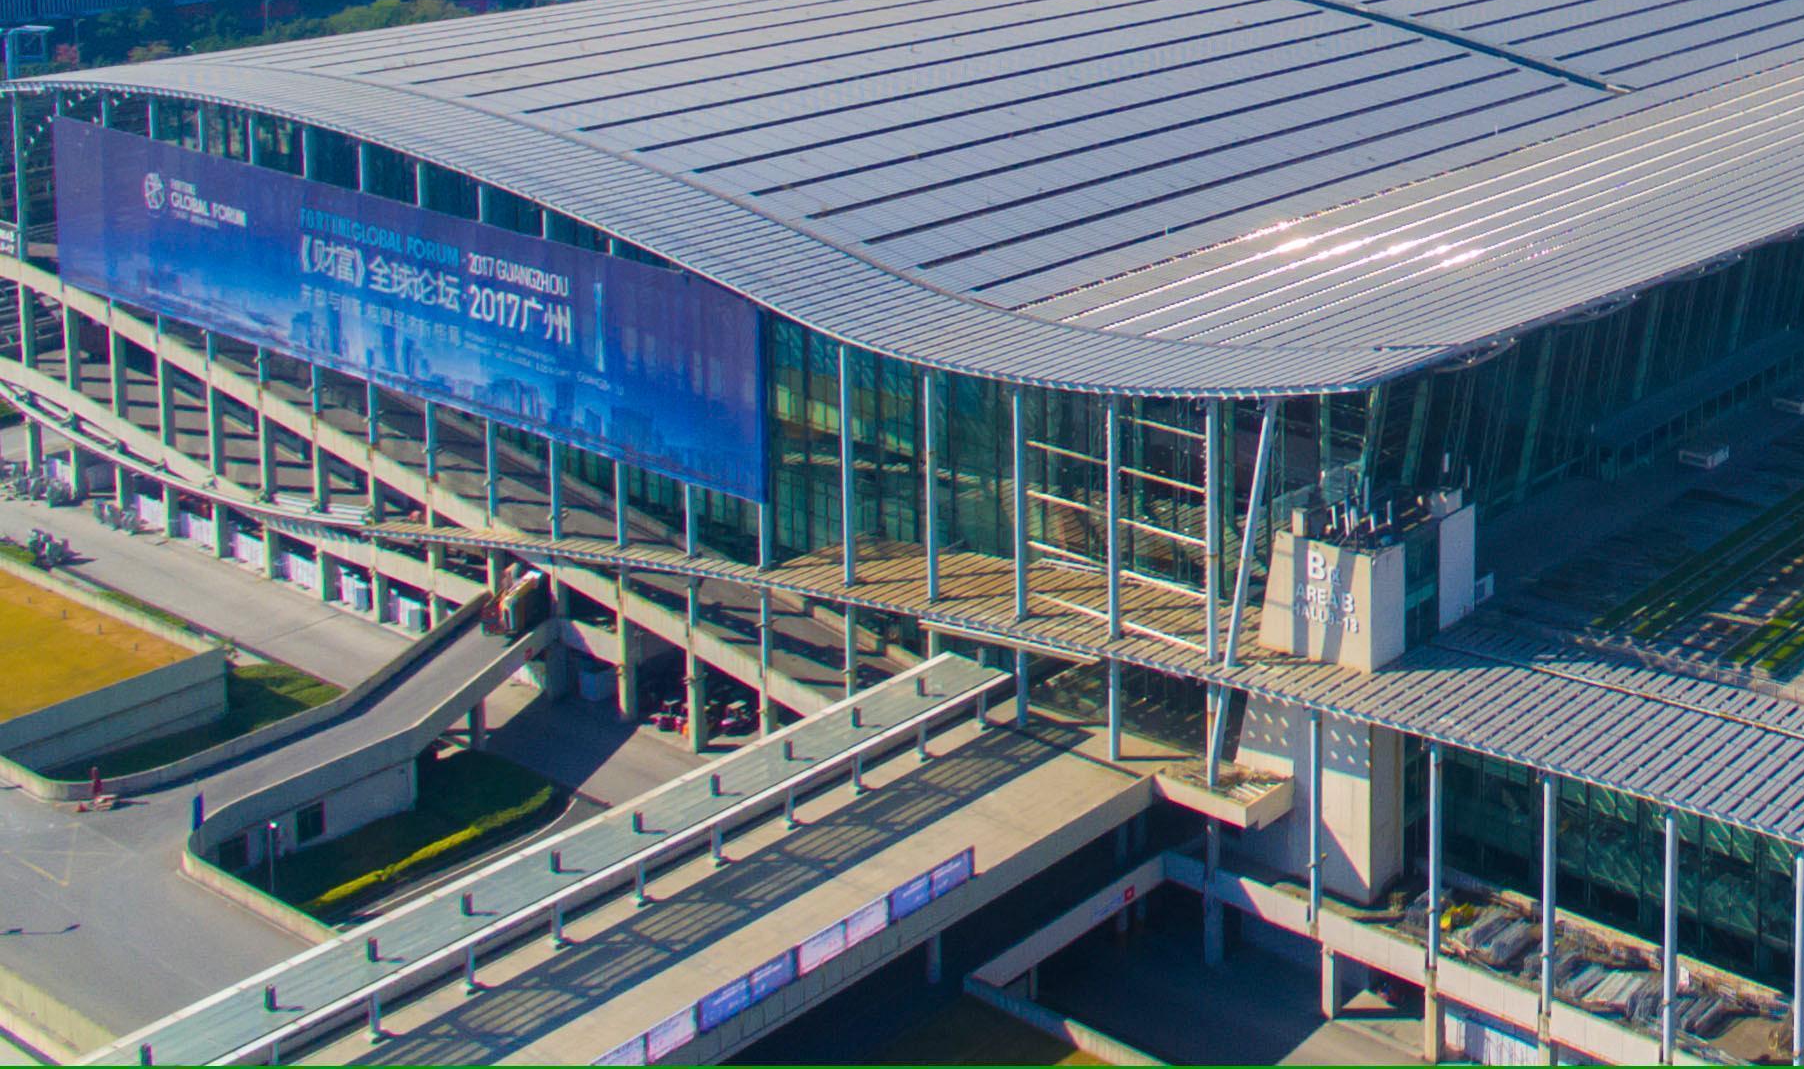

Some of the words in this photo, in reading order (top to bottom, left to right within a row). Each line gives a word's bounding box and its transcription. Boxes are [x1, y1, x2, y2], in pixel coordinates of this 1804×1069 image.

[352, 221, 403, 252] GLOBAL
[406, 235, 460, 267] FORUM
[467, 252, 494, 277] 2017
[495, 259, 569, 297] GUANGZHOU
[1296, 583, 1338, 608] AREA
[1343, 592, 1355, 613] B
